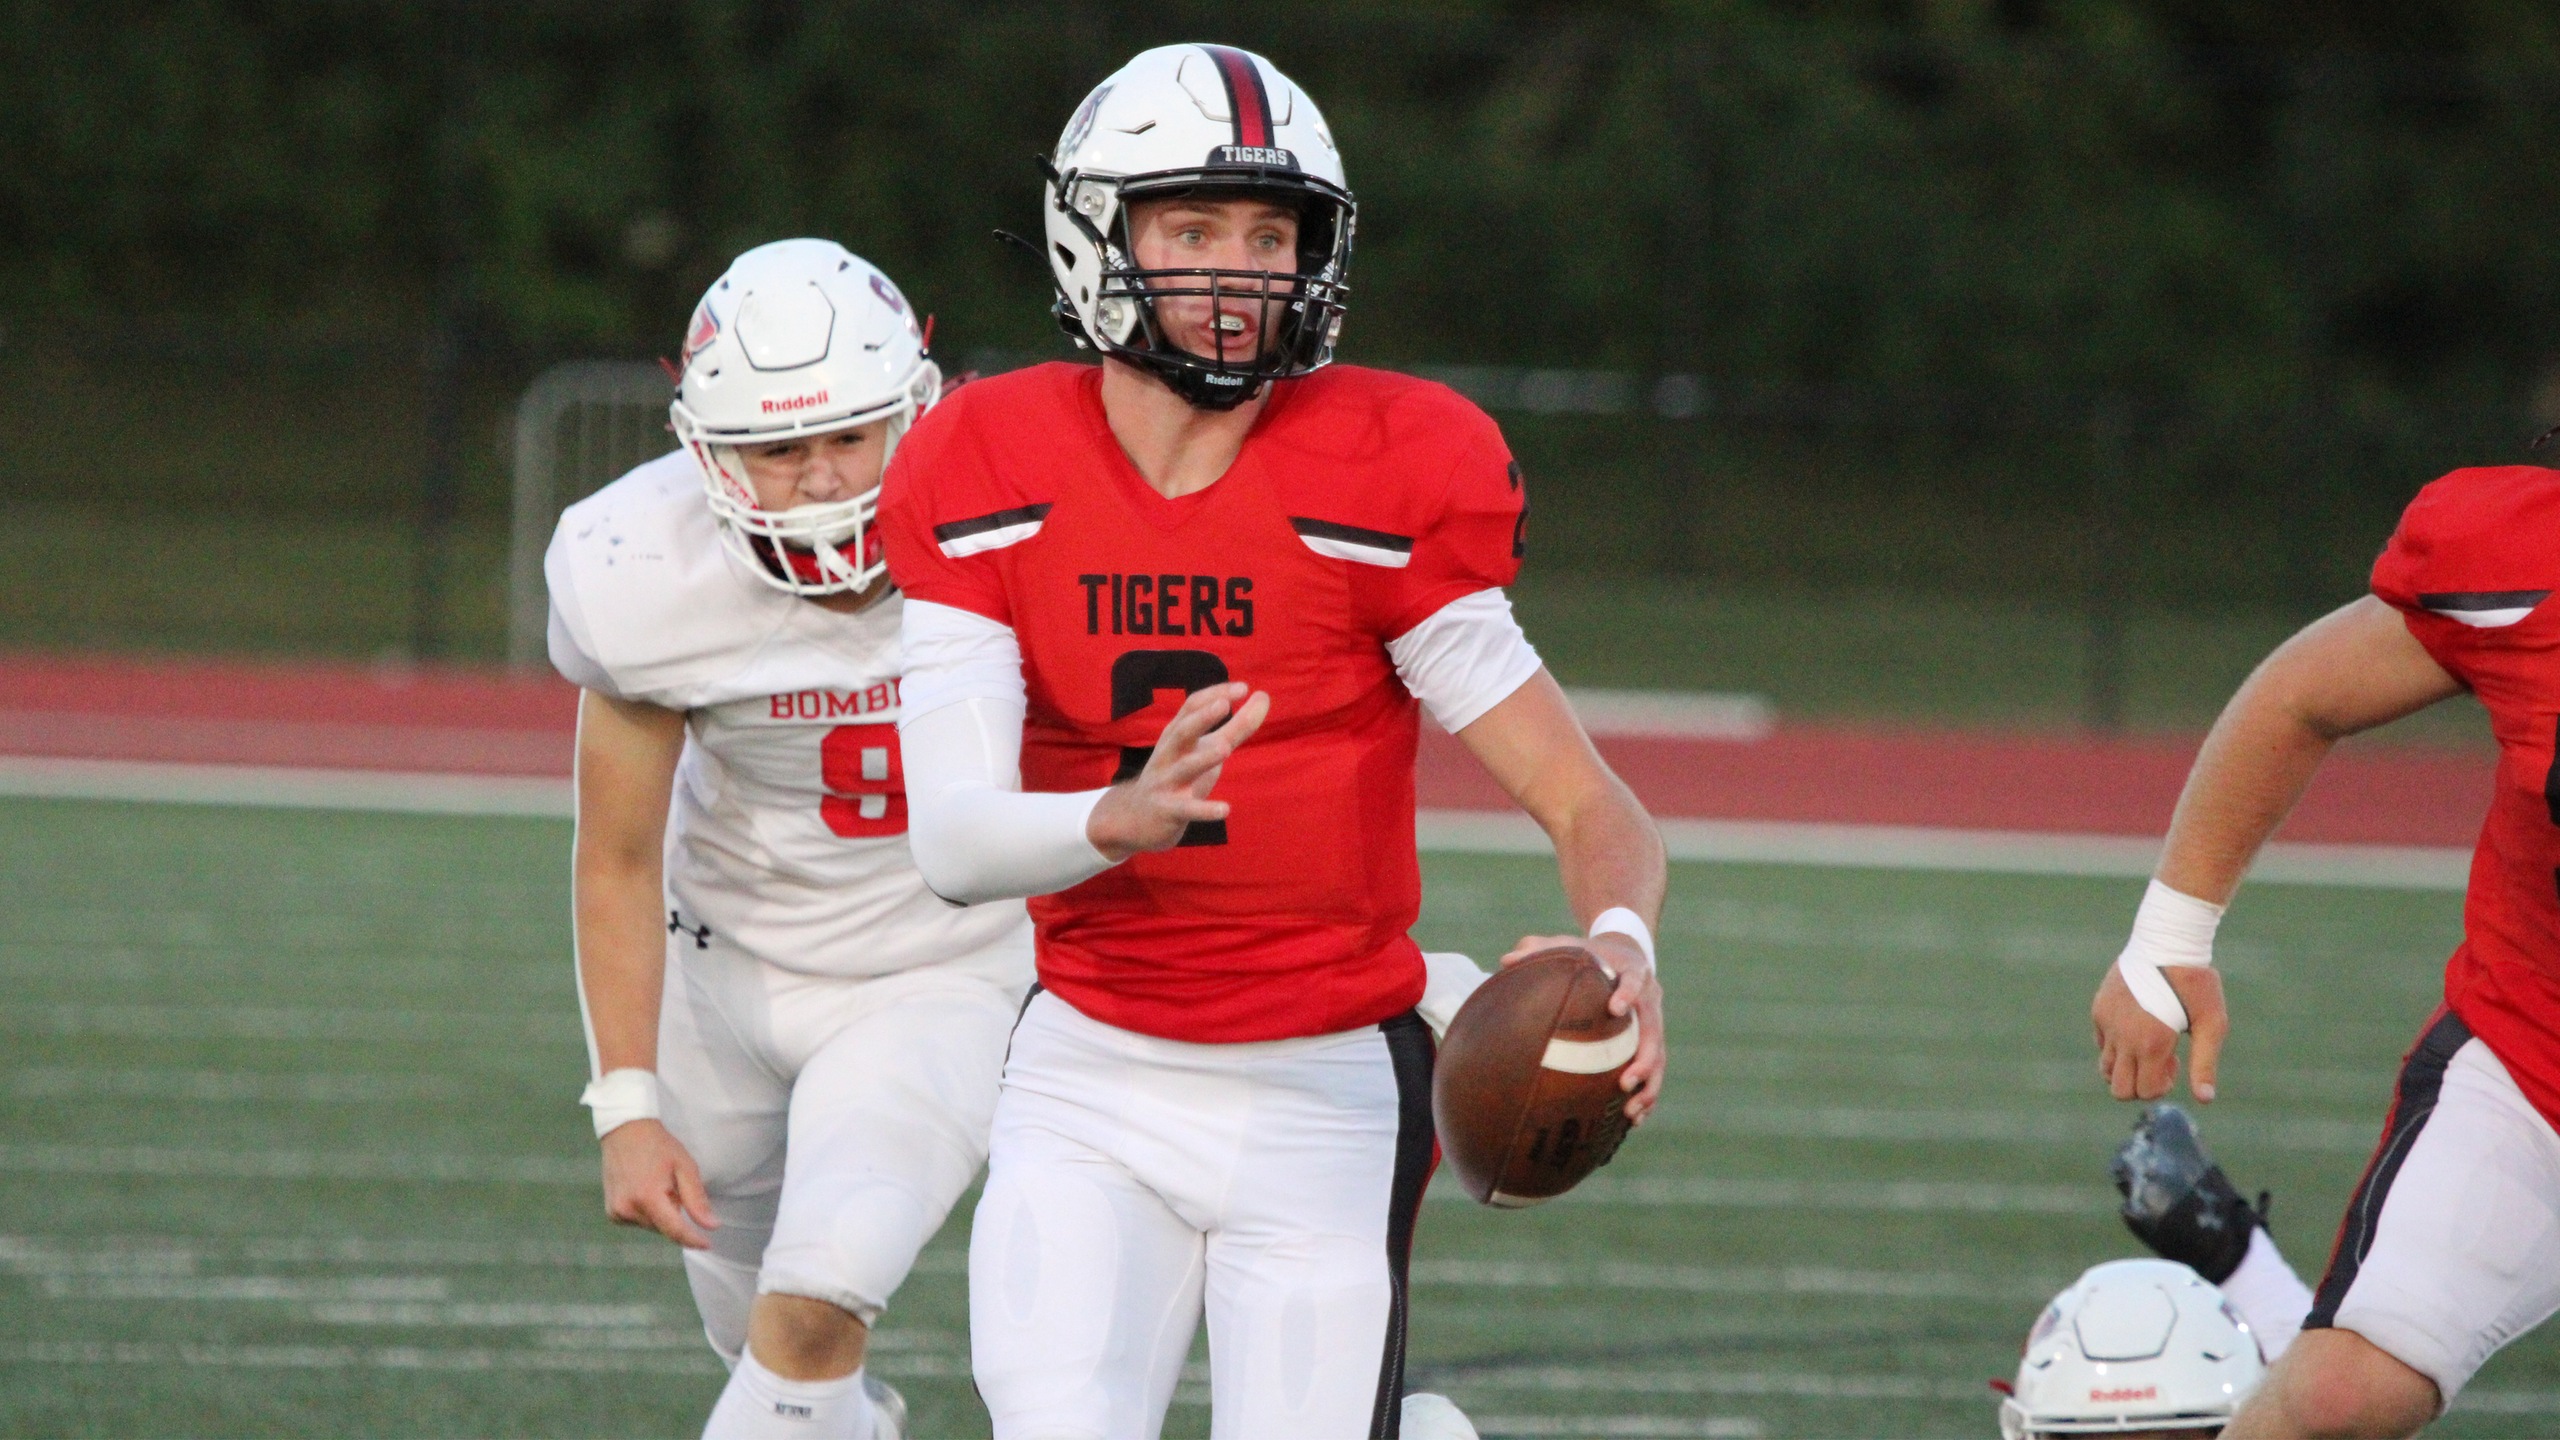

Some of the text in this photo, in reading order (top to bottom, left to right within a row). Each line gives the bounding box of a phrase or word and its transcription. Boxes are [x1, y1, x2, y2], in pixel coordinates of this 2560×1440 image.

[1221, 146, 1288, 166] TIGERS
[1205, 373, 1243, 386] Riddell
[761, 390, 829, 414] Riddell
[1078, 573, 1254, 637] TIGERS
[819, 721, 909, 838] 9
